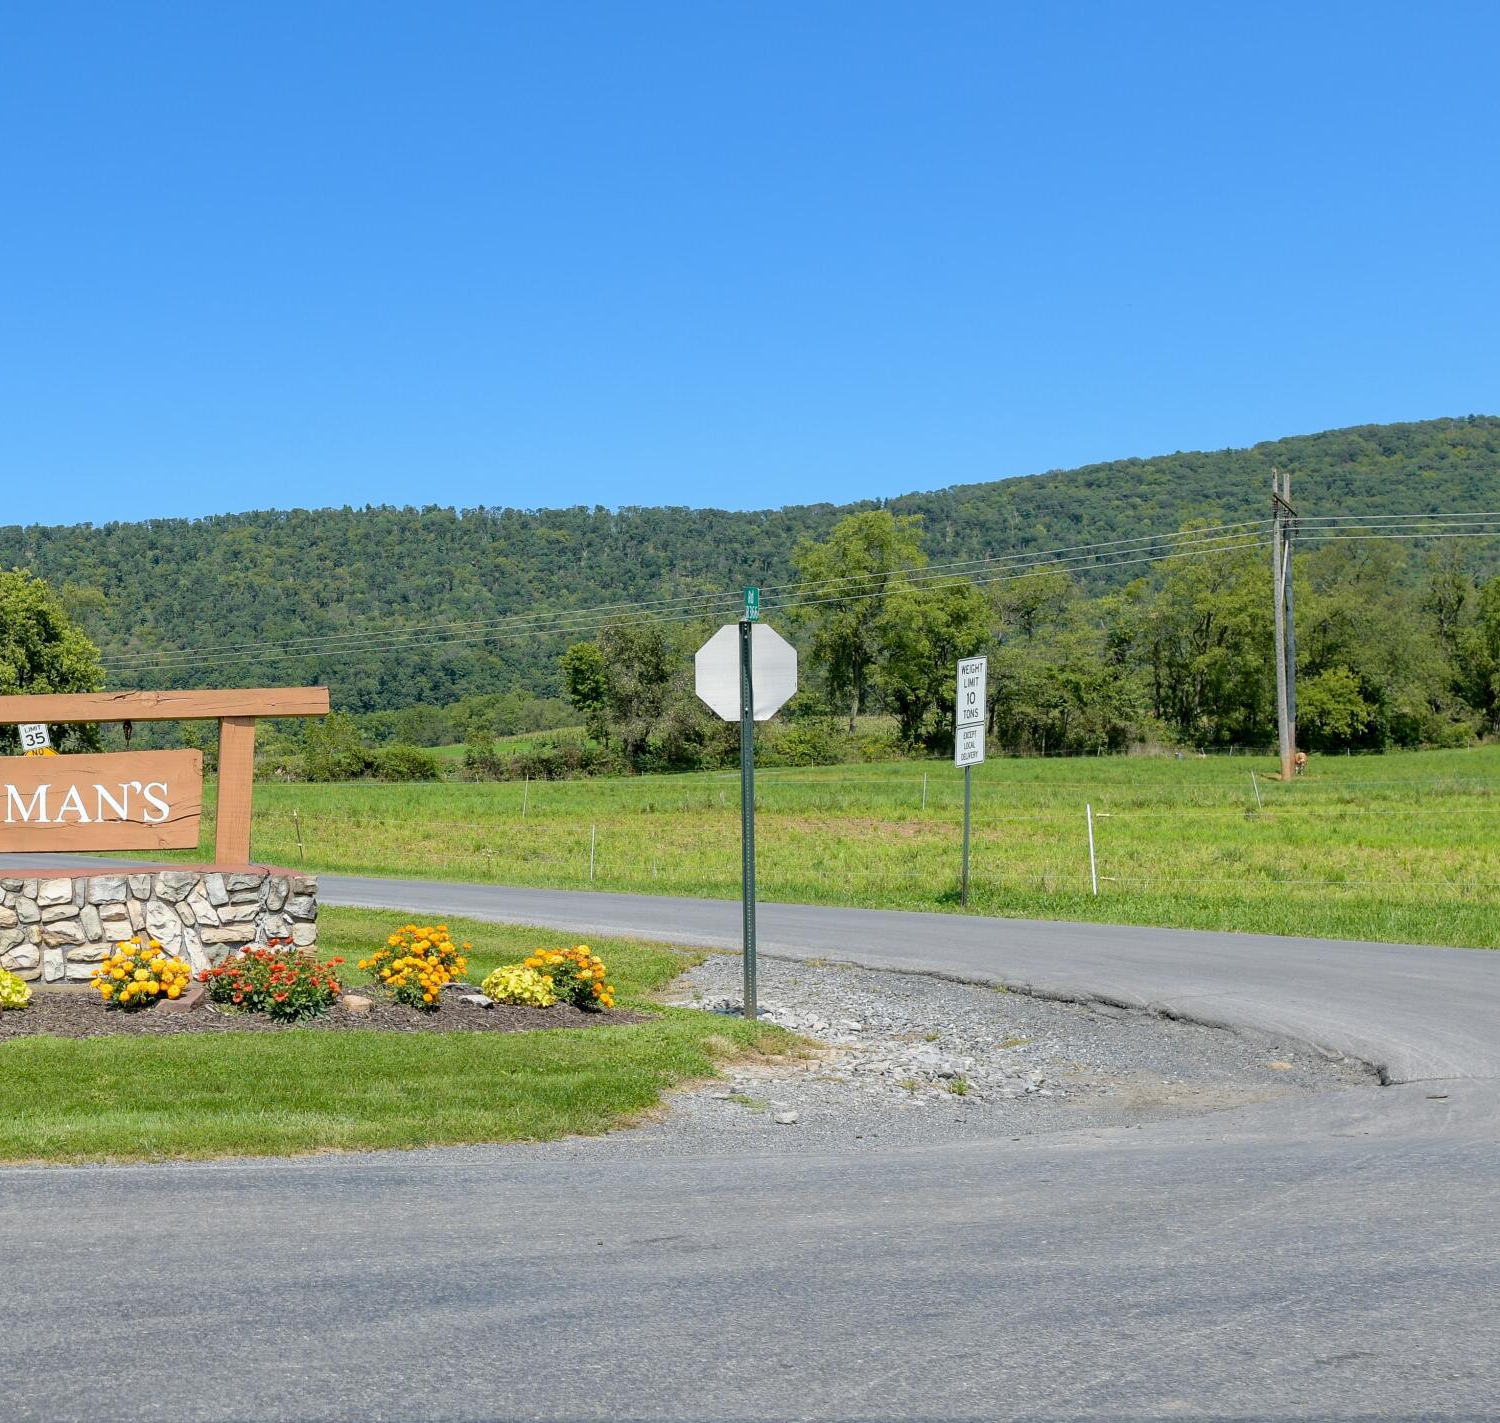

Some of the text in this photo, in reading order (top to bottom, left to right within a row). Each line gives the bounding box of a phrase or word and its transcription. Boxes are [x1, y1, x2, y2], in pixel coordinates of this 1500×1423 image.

[961, 662, 983, 675] WEIGHT
[963, 677, 979, 689] LIMIT
[966, 692, 976, 705] 10
[963, 708, 979, 720] TONS
[24, 725, 41, 733] LIMIT
[963, 730, 977, 740] EXCEPT
[25, 731, 46, 747] 35
[963, 741, 975, 750] LOCAL
[960, 751, 979, 761] DELIVERY
